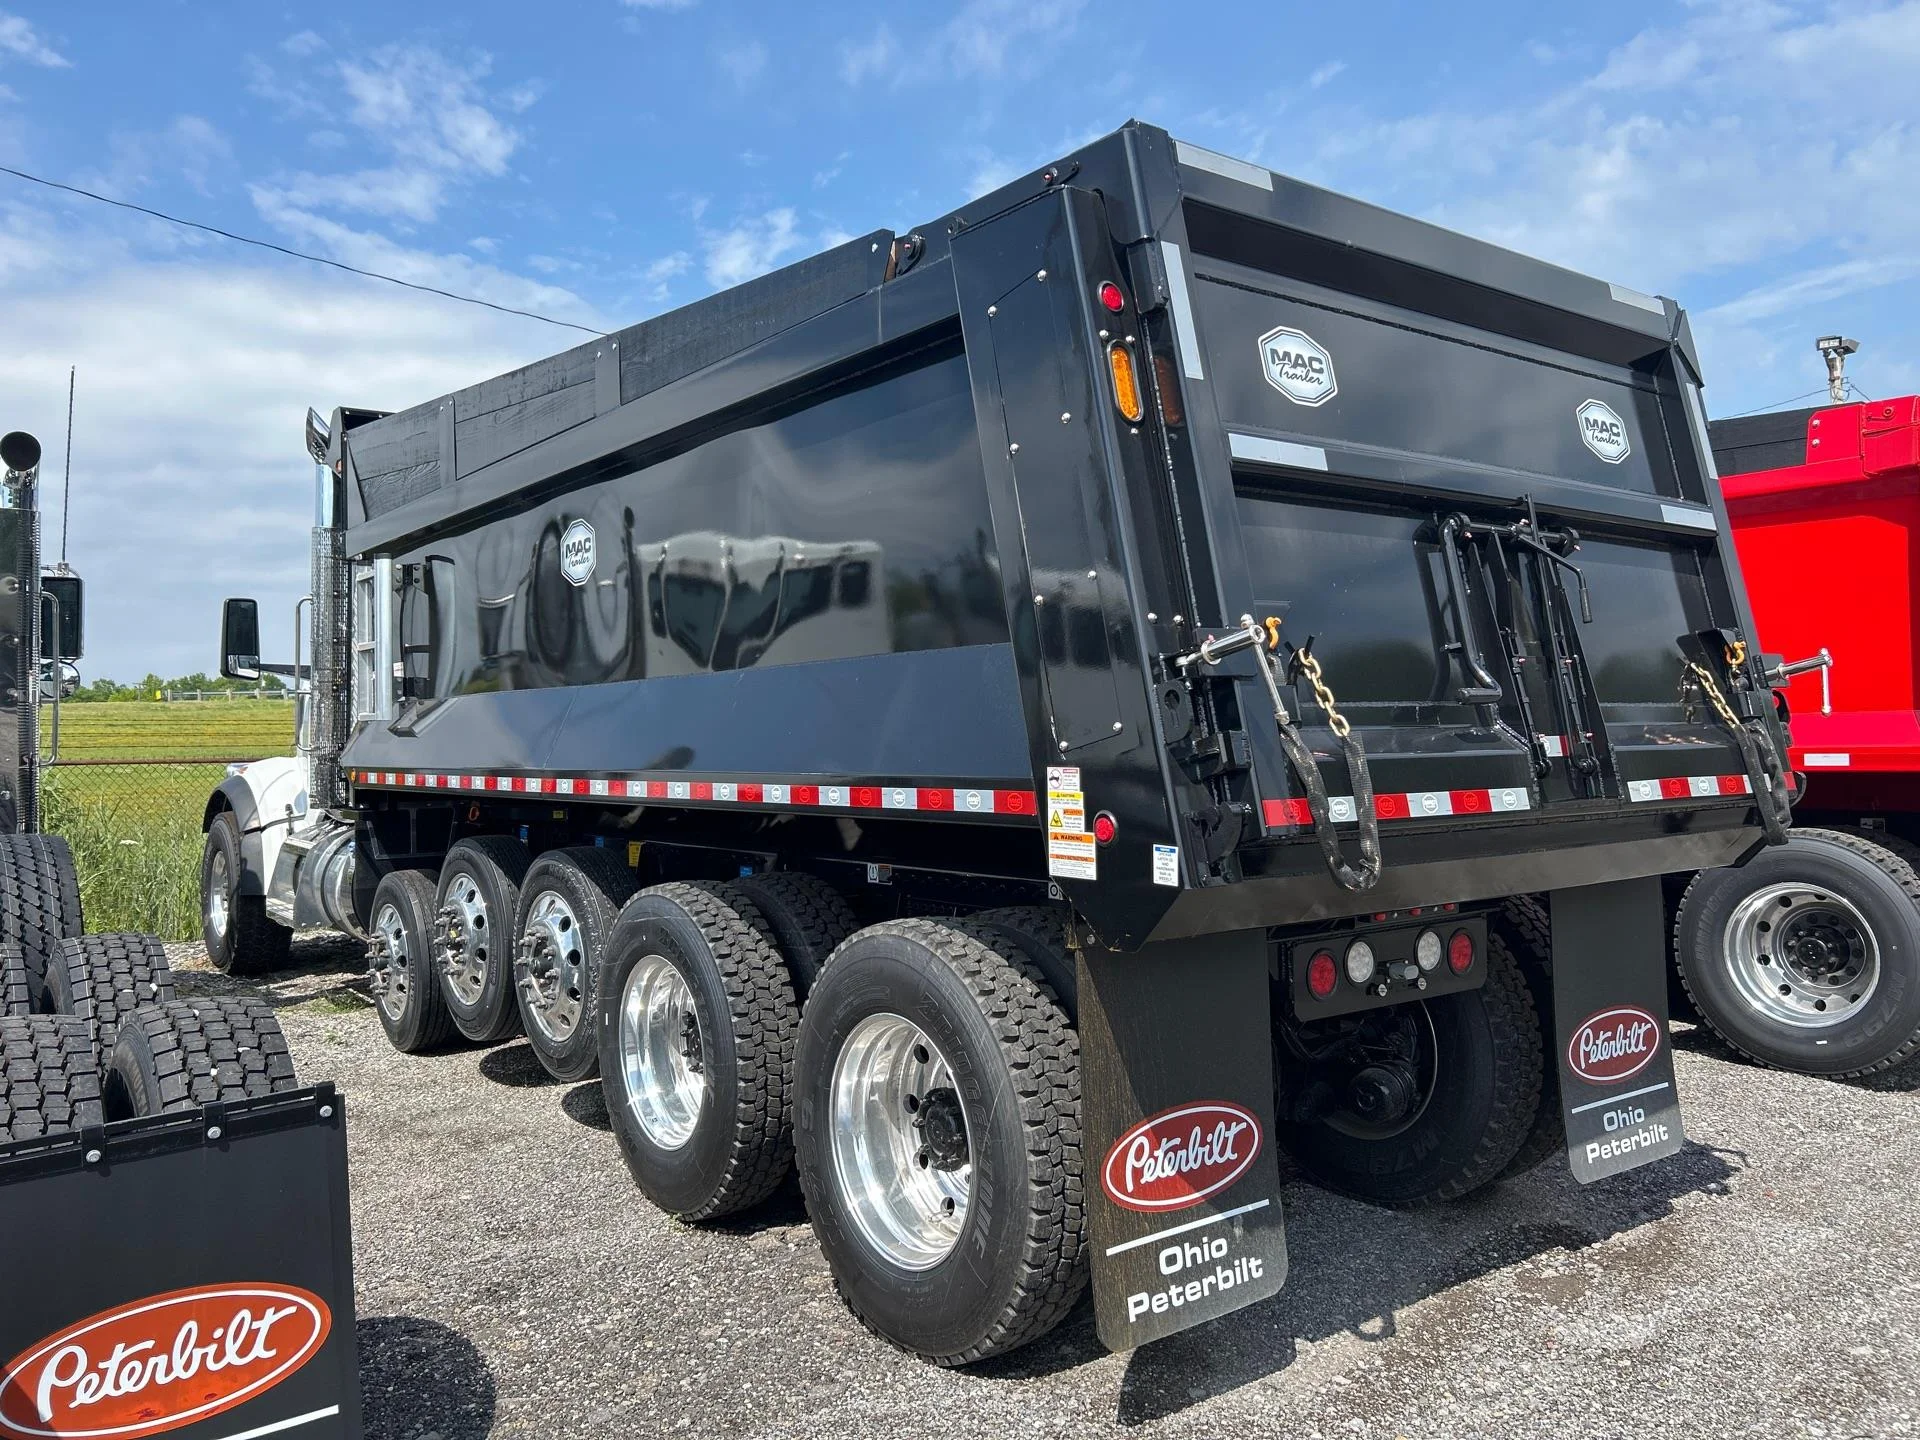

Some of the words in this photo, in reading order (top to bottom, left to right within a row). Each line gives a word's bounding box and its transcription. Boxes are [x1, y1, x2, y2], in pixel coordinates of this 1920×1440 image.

[1270, 348, 1324, 374] MAC
[1275, 362, 1323, 385] Trailer
[1584, 417, 1621, 437] MAC
[1589, 428, 1621, 446] Trailer
[565, 537, 591, 559] MAC
[1579, 1021, 1652, 1070] Peterbilt
[916, 990, 996, 1260] BRIDGESTONE
[1603, 1106, 1645, 1132] Ohio
[1126, 1121, 1247, 1193] Peterbilt
[1586, 1124, 1669, 1164] Peterbilt
[1159, 1236, 1228, 1276] Ohio
[1127, 1256, 1264, 1323] Peterbilt
[37, 1306, 298, 1424] Peterbilt
